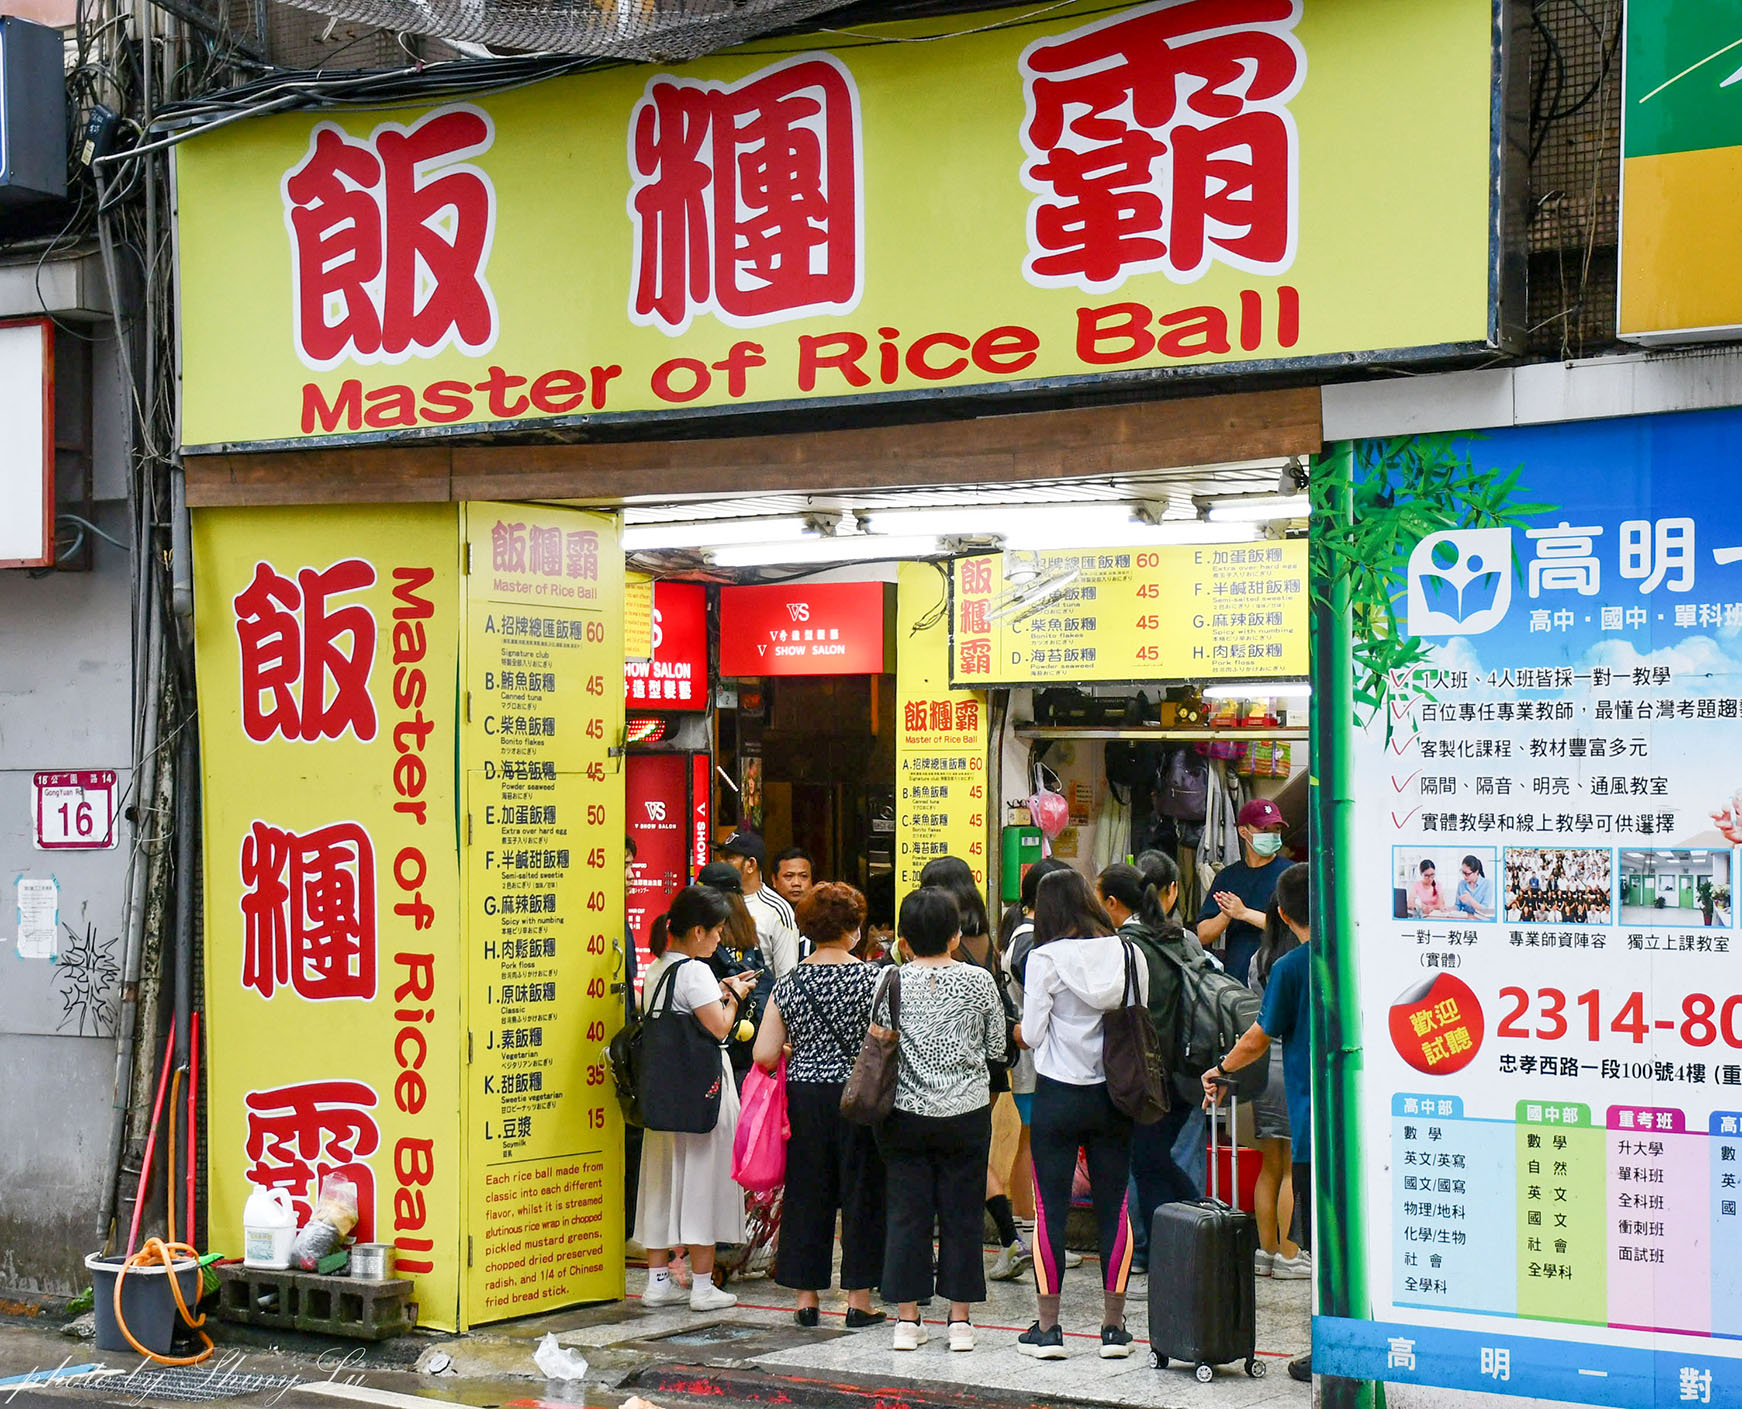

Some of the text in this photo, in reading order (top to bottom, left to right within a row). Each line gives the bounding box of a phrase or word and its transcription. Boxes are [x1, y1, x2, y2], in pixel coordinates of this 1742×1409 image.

[283, 0, 1307, 371] 飯糰霸
[301, 285, 1300, 433] Master of Rice Ball
[492, 520, 599, 581] 飯糰霸
[1136, 552, 1159, 569] 60
[493, 578, 598, 600] Master of Rice Ball
[1135, 584, 1159, 599] 45
[786, 602, 810, 622] VS
[960, 557, 992, 675] 飯糰霸
[586, 621, 604, 643] 60
[1135, 615, 1159, 630] 45
[757, 644, 846, 657] V SHOW SALON
[1135, 646, 1159, 661] 45
[653, 662, 691, 679] SALON
[585, 675, 604, 696] 45
[904, 699, 979, 732] 飯糰霸
[1421, 698, 1742, 722] 百位專任專業教師，最懂台灣考題趨
[585, 718, 604, 739] 45
[586, 762, 606, 782] 45
[969, 757, 983, 771] 60
[101, 773, 112, 784] 14
[44, 788, 84, 798] GongYuan Rd
[969, 785, 983, 799] 45
[57, 801, 94, 837] 16
[587, 805, 605, 825] 50
[644, 801, 666, 821] VS
[969, 813, 983, 827] 45
[1421, 812, 1675, 834] 實體教學和線上教學可供選擇
[696, 802, 706, 867] V SHOW
[587, 848, 605, 868] 45
[968, 841, 983, 855] 45
[586, 891, 605, 912] 40
[391, 566, 435, 1274] Master of Rice Ball
[586, 934, 605, 955] 40
[1401, 929, 1478, 946] 一對一教學
[1509, 930, 1607, 949] 專業師資陣容
[1627, 933, 1730, 953] 獨立上課教室
[501, 961, 536, 969] Pork floss
[586, 978, 605, 999] 40
[501, 1006, 526, 1014] Classic
[1409, 997, 1461, 1037] 歡迎
[586, 1021, 605, 1042] 40
[1421, 1026, 1473, 1066] 試聽
[586, 1064, 605, 1086] 35
[1403, 1097, 1453, 1117] 高中部
[1526, 1104, 1579, 1124] 國中部
[587, 1108, 605, 1129] 15
[1618, 1110, 1673, 1130] 重考班
[1618, 1140, 1664, 1157] 升大學
[485, 1162, 604, 1186] Each rice ball made from
[1618, 1166, 1664, 1183] 單科班
[485, 1179, 602, 1203] classic into each different
[517, 1204, 542, 1215] whilst
[545, 1202, 552, 1212] it
[555, 1201, 563, 1210] is
[565, 1194, 603, 1209] streamed
[1403, 1201, 1466, 1220] 物理/地科
[1618, 1193, 1664, 1210] 全科班
[485, 1210, 603, 1240] glutinous rice wrap in chopped
[1618, 1219, 1664, 1237] 衝刺班
[485, 1240, 522, 1257] pickled
[524, 1234, 565, 1250] mustard
[1403, 1226, 1466, 1246] 化學/生物
[485, 1244, 603, 1273] chopped dried preserved
[1618, 1245, 1665, 1264] 面試班
[520, 1272, 537, 1285] and
[541, 1270, 555, 1281] 1/4
[557, 1266, 567, 1278] of
[569, 1262, 604, 1276] Chinese
[1528, 1261, 1573, 1281] 全學科
[1404, 1276, 1447, 1295] 全學科
[485, 1284, 570, 1308] fried bread stick.
